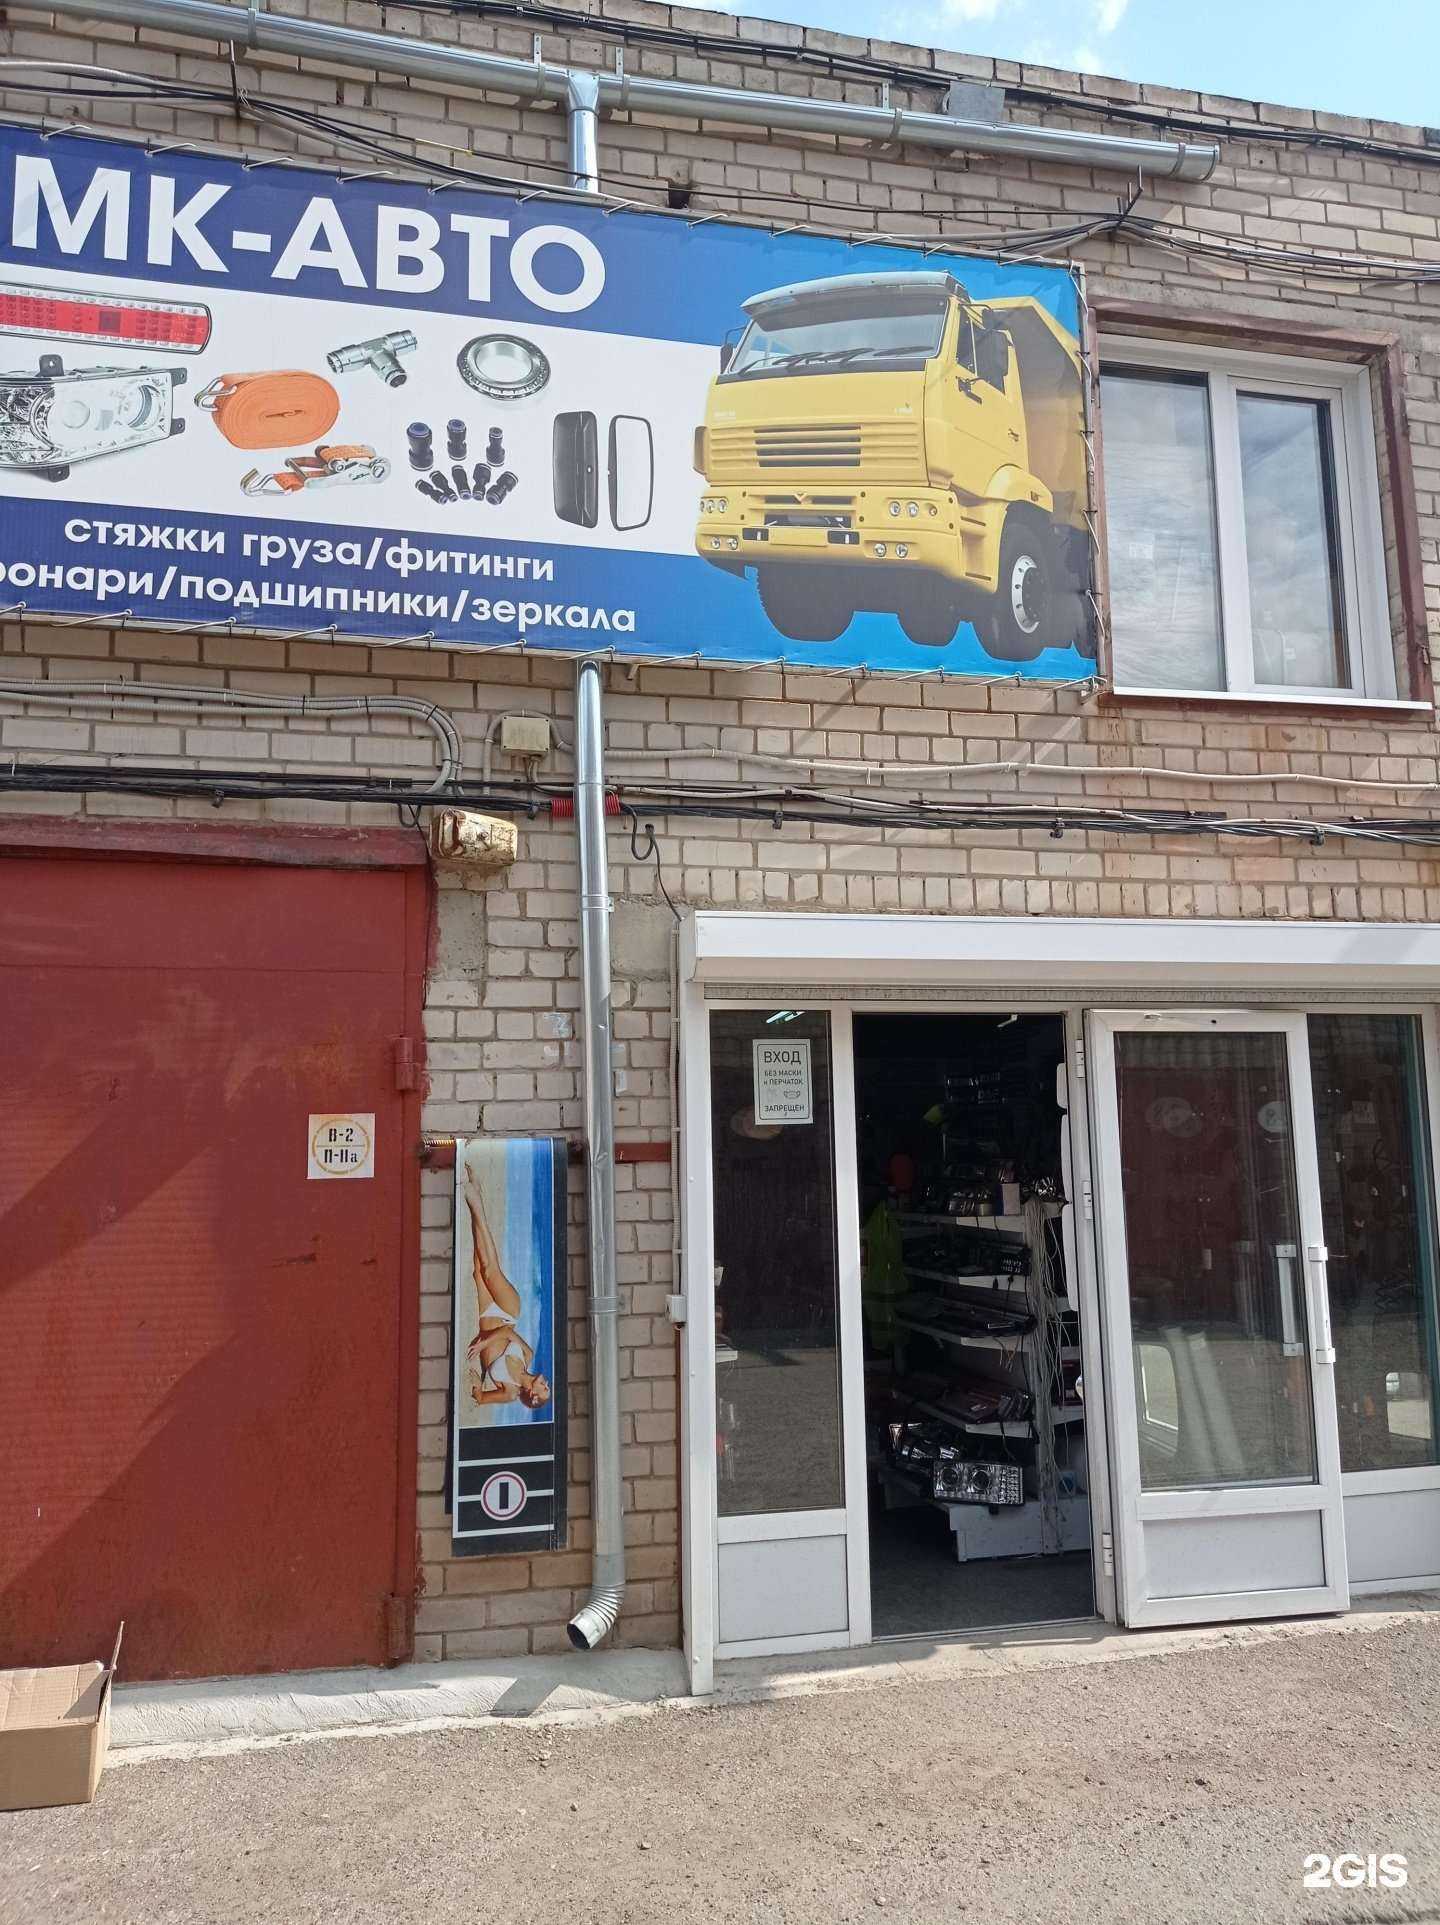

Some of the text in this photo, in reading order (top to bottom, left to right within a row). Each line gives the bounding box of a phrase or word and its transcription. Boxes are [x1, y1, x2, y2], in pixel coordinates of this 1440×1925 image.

[11, 154, 606, 313] МК-АВТО
[64, 518, 554, 582] стяжки груза/фитинги
[763, 1051, 802, 1065] ВХОД
[778, 1069, 802, 1077] МАСКИ
[769, 1078, 804, 1086] ПЕРЧАТОК
[764, 1104, 805, 1112] ЗАПРЕЩЕН
